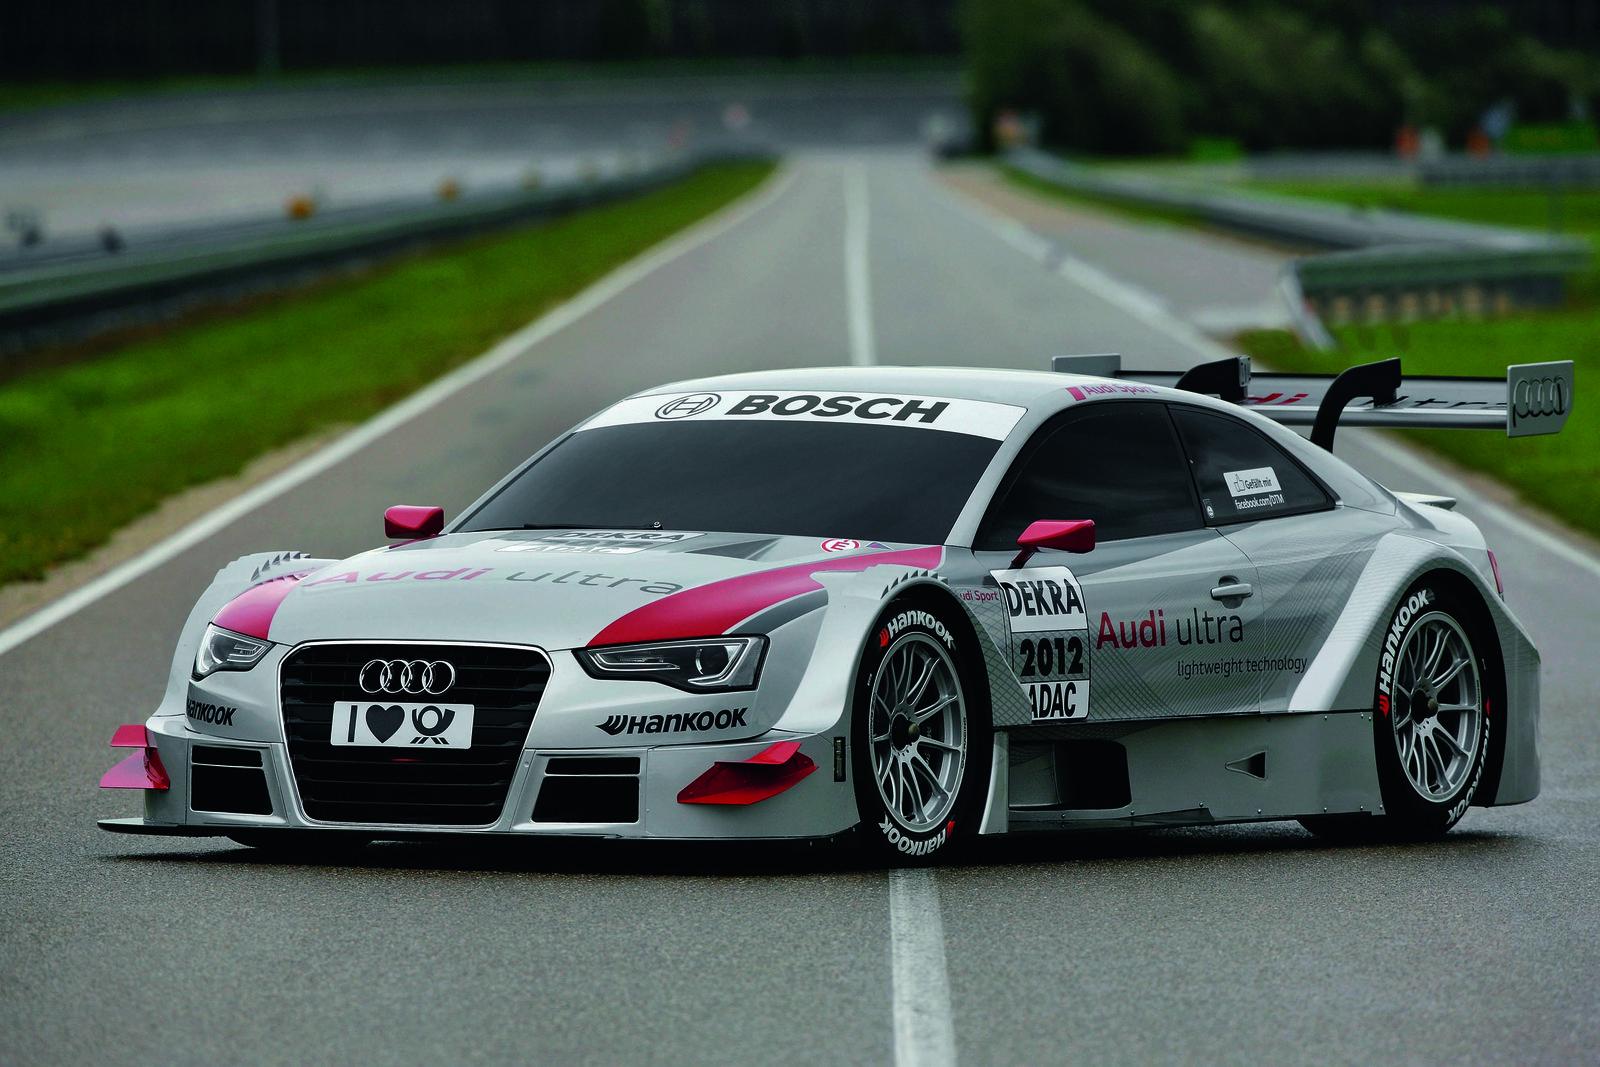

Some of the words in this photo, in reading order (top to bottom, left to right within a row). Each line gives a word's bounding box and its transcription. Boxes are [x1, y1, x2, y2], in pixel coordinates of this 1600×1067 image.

[1080, 384, 1118, 395] Audi
[724, 394, 950, 424] BOSCH
[554, 532, 685, 541] DEKRA
[302, 567, 496, 587] Audi
[505, 570, 685, 595] ultra
[974, 590, 999, 603] Sport
[1000, 578, 1085, 617] DEKRA
[1096, 608, 1167, 650] Audi
[1176, 607, 1244, 646] ultra
[1019, 636, 1085, 677] 2012
[1177, 657, 1244, 680] lightweight
[1246, 655, 1308, 674] technology
[347, 704, 359, 743] I
[626, 707, 748, 735] HanKOOK
